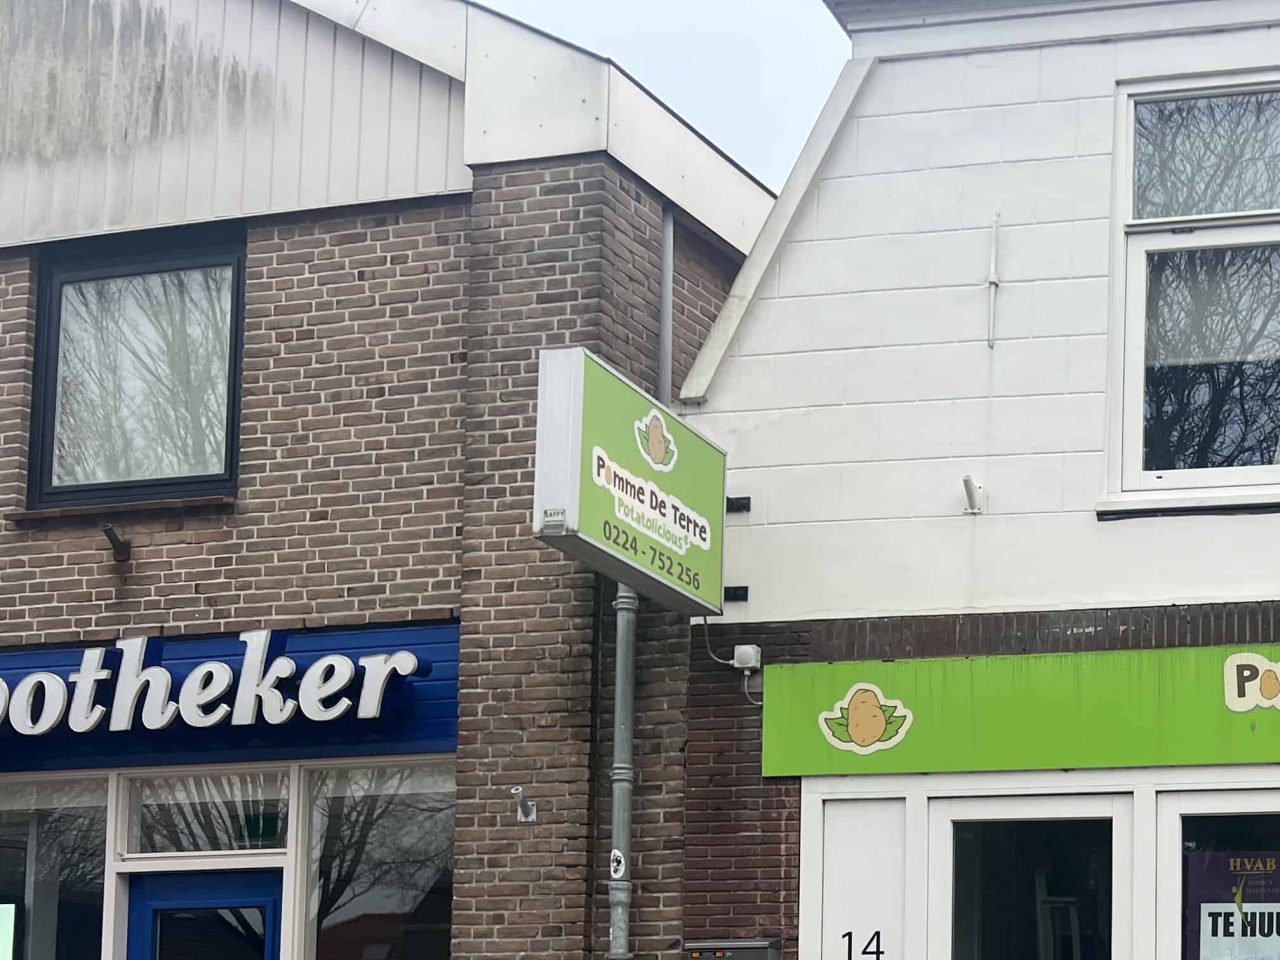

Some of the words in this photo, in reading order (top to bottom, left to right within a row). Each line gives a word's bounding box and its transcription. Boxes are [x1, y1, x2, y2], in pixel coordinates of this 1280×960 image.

[617, 498, 683, 549] Potatolicious
[650, 490, 667, 517] De
[672, 504, 707, 542] Terre
[0, 628, 418, 735] otheker
[1229, 858, 1277, 872] HVAB
[1208, 911, 1235, 937] TE
